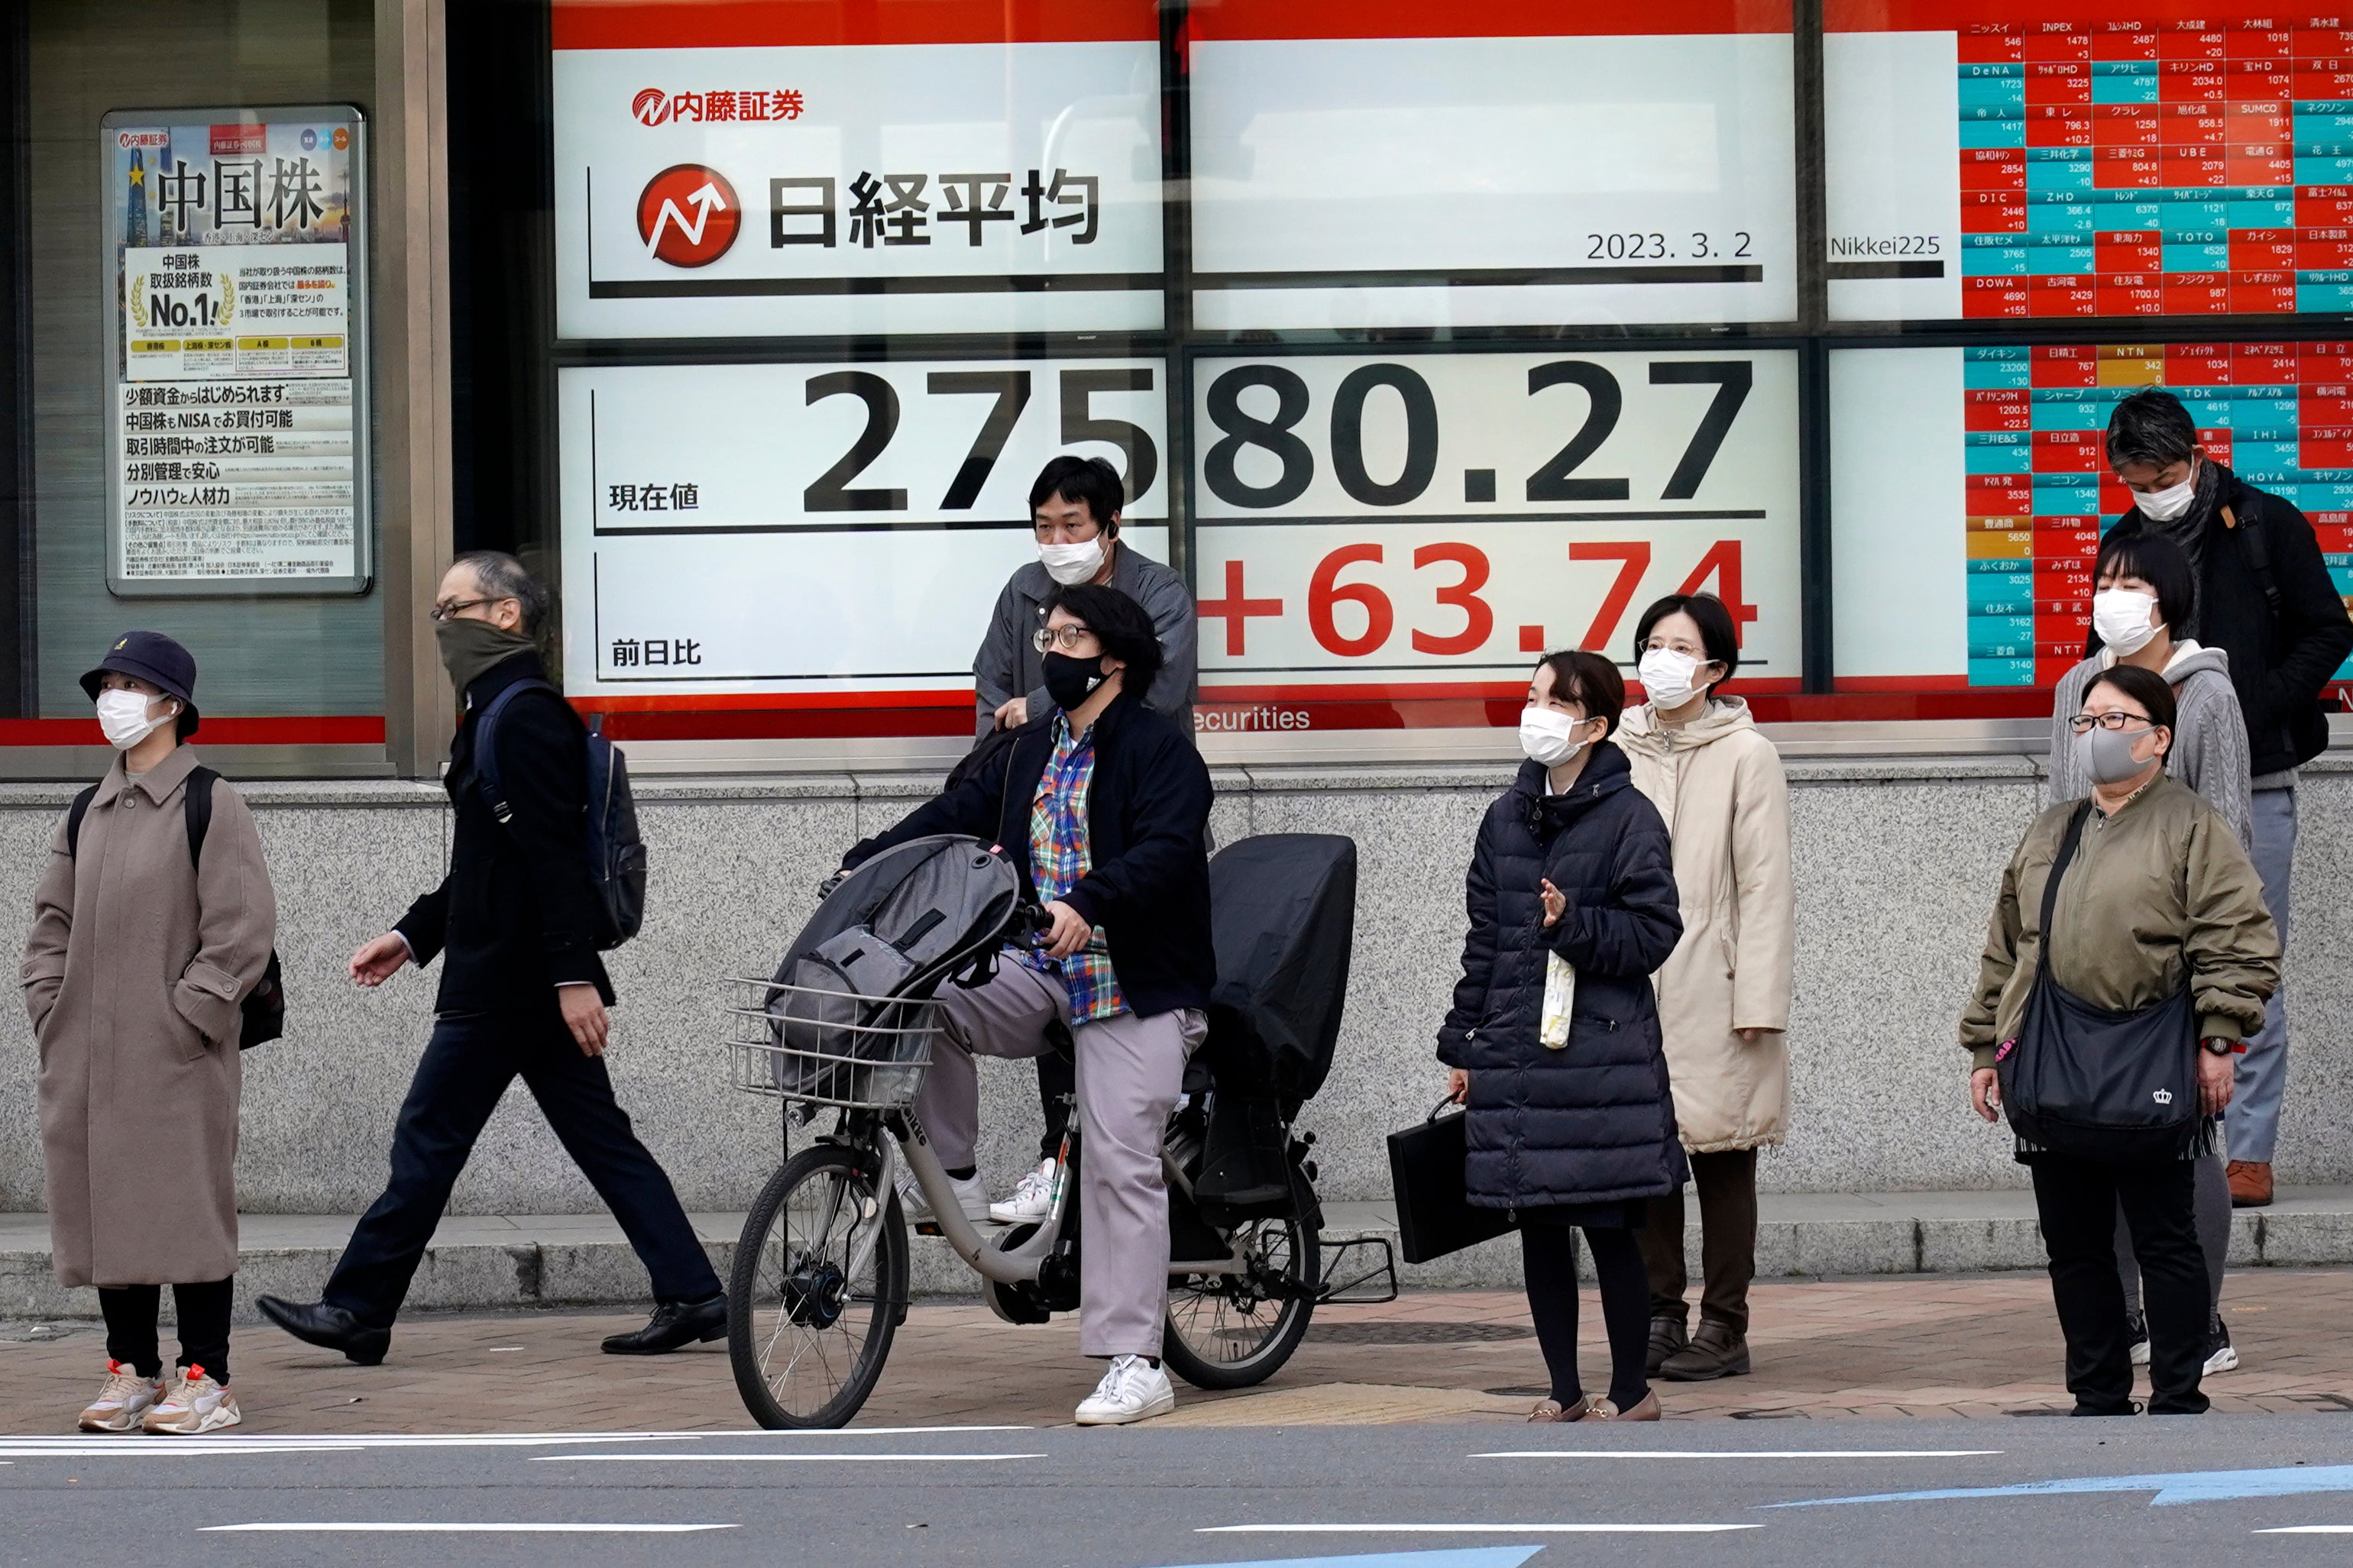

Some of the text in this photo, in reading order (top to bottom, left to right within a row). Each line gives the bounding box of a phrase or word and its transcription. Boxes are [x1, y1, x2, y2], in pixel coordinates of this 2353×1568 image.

[2042, 23, 2071, 31] INPEX
[2005, 37, 2021, 46] 546
[2132, 35, 2154, 44] 2487
[2199, 34, 2222, 43] 4480
[2267, 33, 2289, 41] 1018
[2206, 48, 2222, 57] +20
[2000, 79, 2021, 89] 1723
[2067, 79, 2089, 87] 3225
[2192, 76, 2222, 86] 2034.0
[2267, 76, 2289, 84] 1074
[673, 89, 804, 122] 内藤証券
[2241, 105, 2277, 113] SUMCO
[2001, 122, 2022, 131] 1417
[2065, 121, 2089, 130] 796.3
[2135, 120, 2157, 128] 1258
[2268, 118, 2288, 127] 1911
[131, 133, 167, 146] 内藤証券
[2065, 135, 2089, 144] +10.2
[2001, 164, 2023, 173] 2854
[2202, 161, 2224, 170] 2079
[158, 157, 324, 231] 中国株
[769, 168, 1099, 248] 日経平均
[2002, 207, 2024, 215] 2446
[2202, 203, 2223, 212] 1121
[2008, 221, 2024, 229] +10
[1830, 235, 1940, 257] Nikkei225
[2138, 247, 2159, 256] 1340
[162, 253, 200, 270] 中国株
[150, 272, 212, 289] 取扱銘柄数
[1976, 279, 2012, 287] DOWA
[2003, 292, 2026, 300] 4690
[2070, 291, 2092, 299] 2429
[2130, 289, 2159, 299] 1700.0
[2209, 289, 2225, 297] 987
[151, 293, 219, 327] No.1!
[2004, 306, 2026, 314] +155
[2135, 303, 2160, 312] +10.0
[2077, 362, 2094, 370] 767
[2206, 360, 2228, 368] 1034
[2273, 359, 2295, 367] 2414
[126, 386, 285, 406] 少額資金からはじめられます
[1999, 406, 2028, 414] 1200.5
[2003, 419, 2028, 428] +22.5
[126, 435, 274, 456] 取引時間中の注文が可能
[2079, 447, 2096, 455] 912
[127, 461, 220, 481] 分別管理で安心
[128, 486, 229, 506] ノウハウと人材力
[609, 483, 699, 512] 現在値
[2007, 490, 2029, 499] 3535
[2075, 490, 2096, 498] 1340
[2074, 532, 2097, 540] 4048
[2008, 575, 2031, 584] 3025
[612, 638, 701, 666] 前日比
[2010, 661, 2032, 669] 3140
[1193, 706, 1311, 731] ecurities
